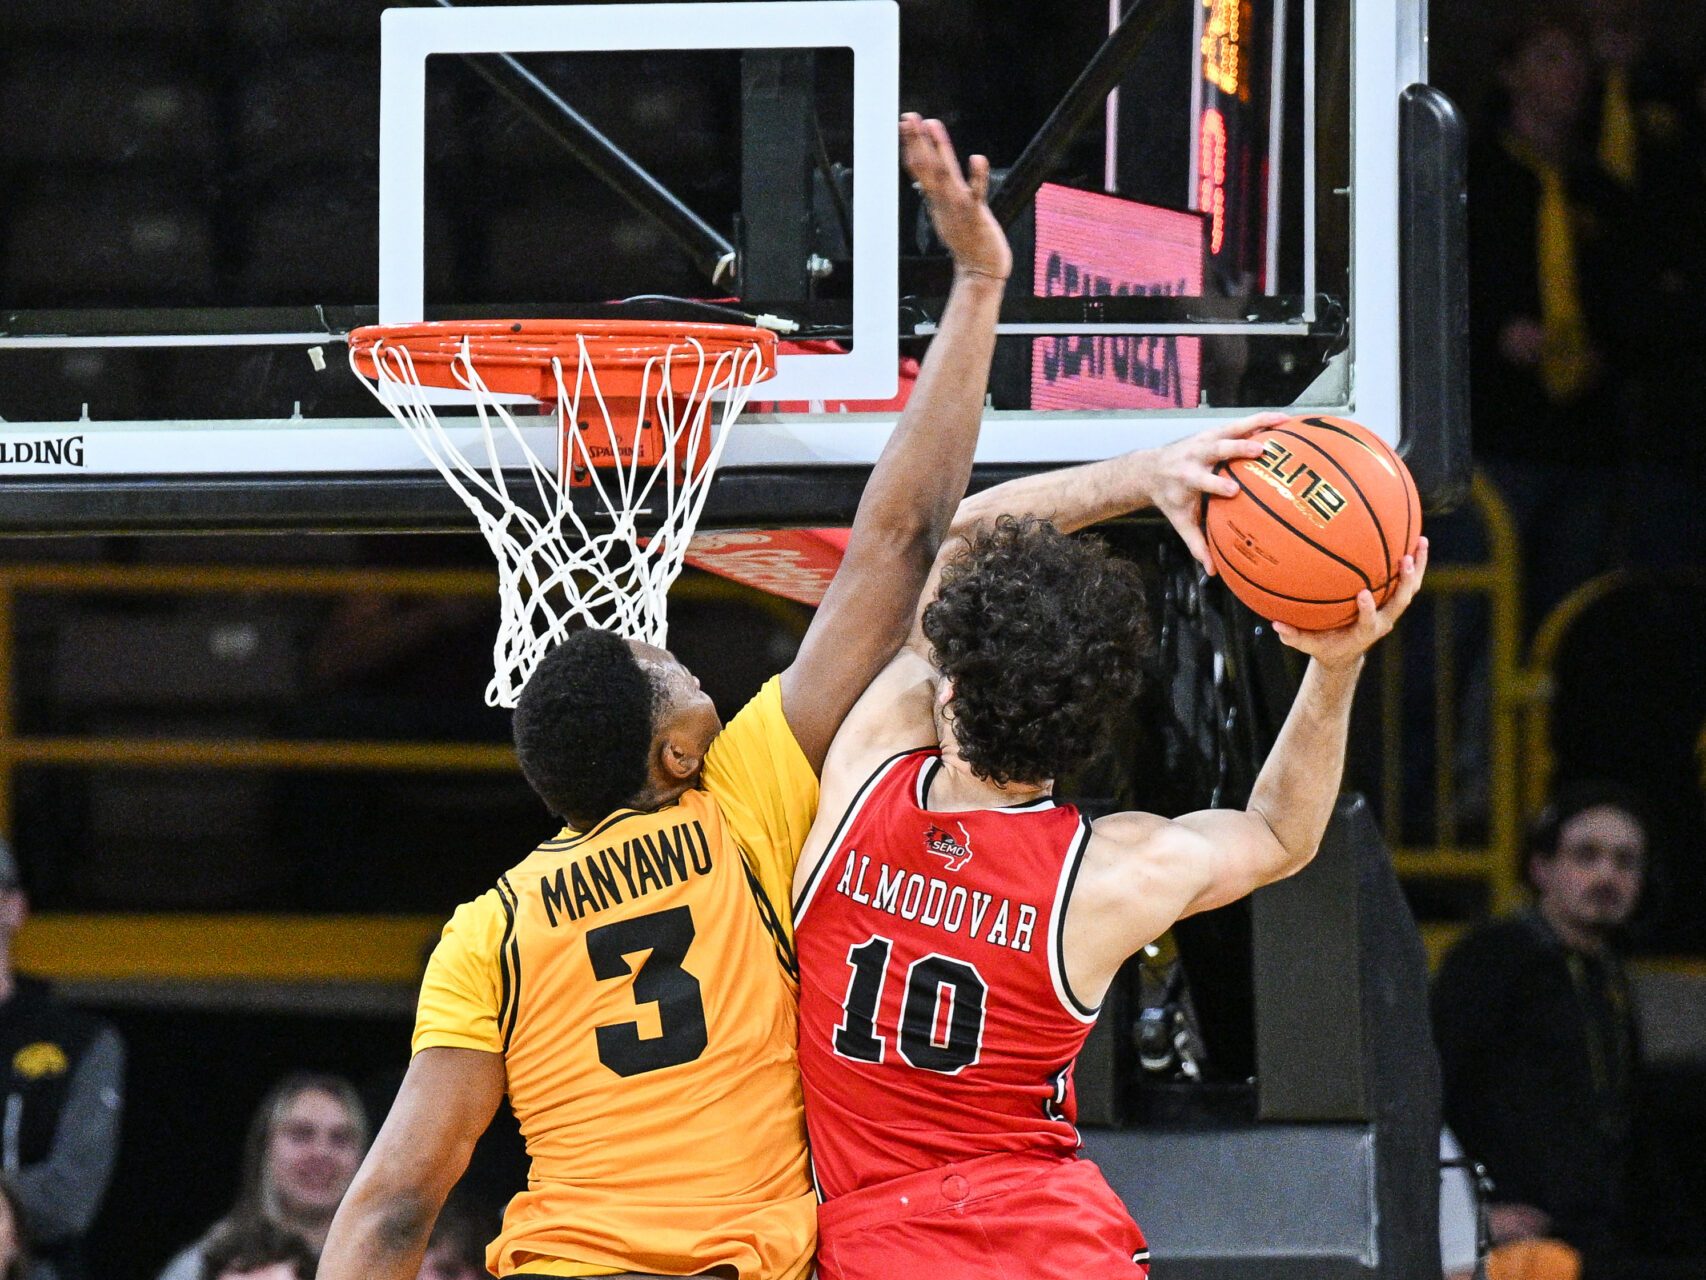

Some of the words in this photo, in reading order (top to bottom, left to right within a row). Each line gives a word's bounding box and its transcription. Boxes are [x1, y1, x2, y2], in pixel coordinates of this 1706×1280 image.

[0, 434, 84, 467] LDING
[1254, 438, 1347, 522] ELITE
[540, 820, 713, 928] MANYAWU
[932, 840, 965, 857] SEMO
[836, 849, 1038, 953] ALMODOVAR
[586, 904, 708, 1078] 3
[832, 934, 989, 1076] 10
